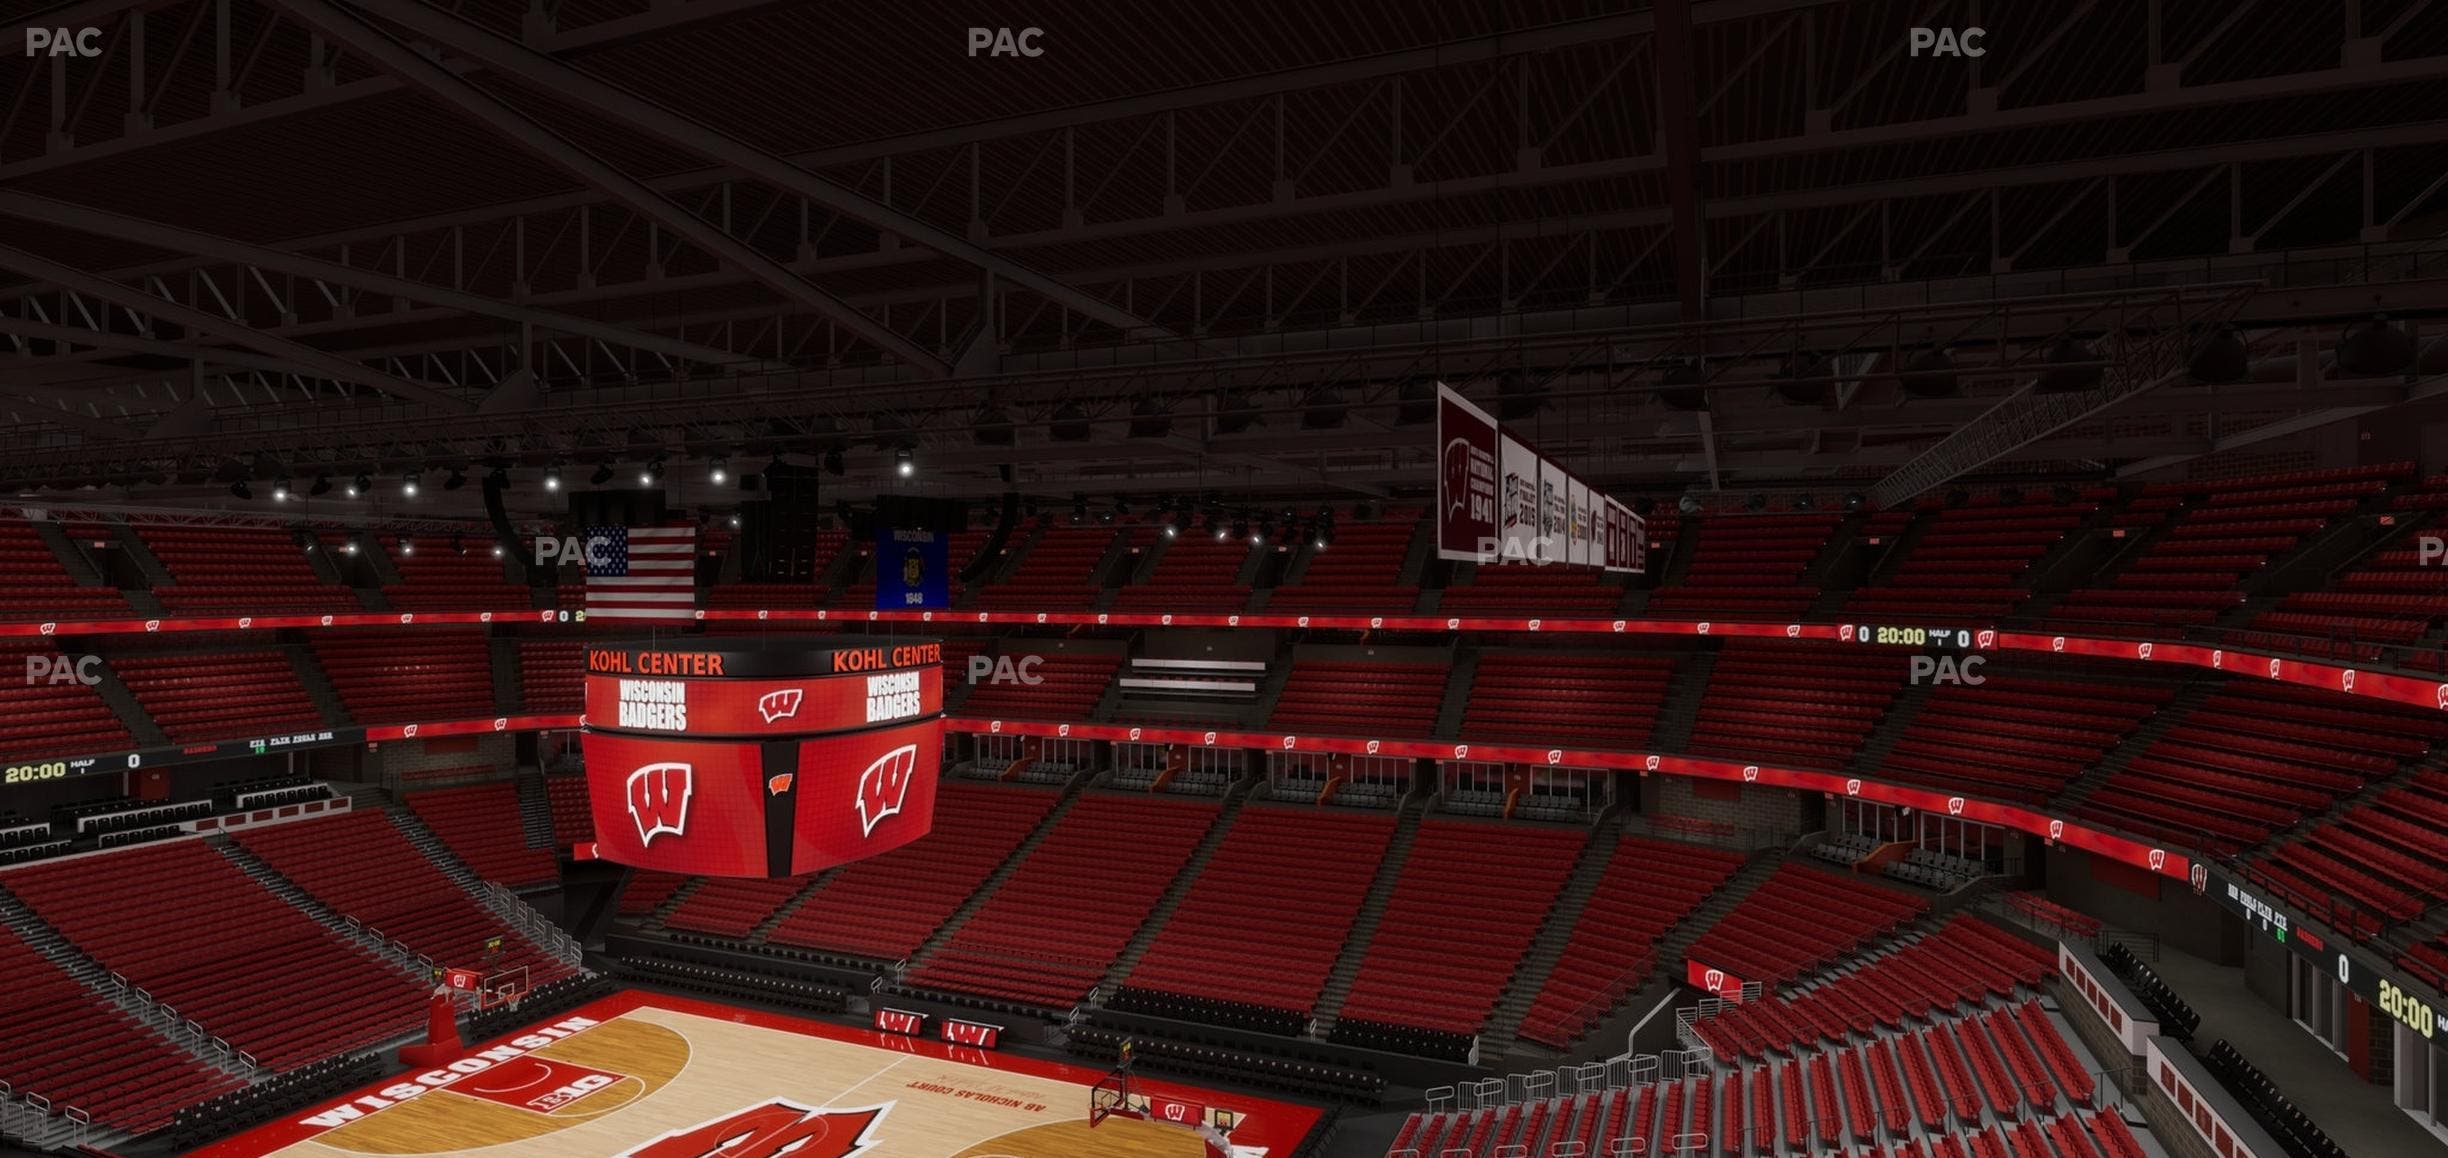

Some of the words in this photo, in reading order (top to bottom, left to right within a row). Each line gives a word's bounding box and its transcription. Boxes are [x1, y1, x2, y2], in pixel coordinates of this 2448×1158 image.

[1470, 493, 1493, 524] 1941
[1859, 626, 1870, 642] 0
[1877, 627, 1926, 645] 20:00
[1929, 629, 1951, 638] HALF
[1957, 630, 1970, 648] 0
[590, 650, 632, 673] KOHL
[638, 653, 724, 676] CENTER
[834, 649, 887, 672] KOHL
[892, 643, 940, 667] CENTER
[619, 679, 686, 704] WISCONSIN
[867, 671, 920, 697] WISCONSIN
[619, 701, 687, 731] BADGERS
[758, 689, 803, 724] W
[866, 691, 921, 723] BADGERS
[5, 762, 66, 784] 20:00
[70, 758, 96, 769] HALF
[128, 754, 140, 769] 0
[768, 774, 793, 797] W
[855, 745, 917, 838] W
[627, 763, 692, 848] W
[1705, 969, 1724, 992] W
[2338, 953, 2349, 984] 0
[2379, 978, 2434, 1039] 20:00
[299, 1016, 600, 1128] WISCONSIN
[906, 1081, 954, 1095] COURT
[955, 1090, 1022, 1108] NICHOLAS
[1024, 1103, 1046, 1112] AB
[1165, 1103, 1185, 1121] W
